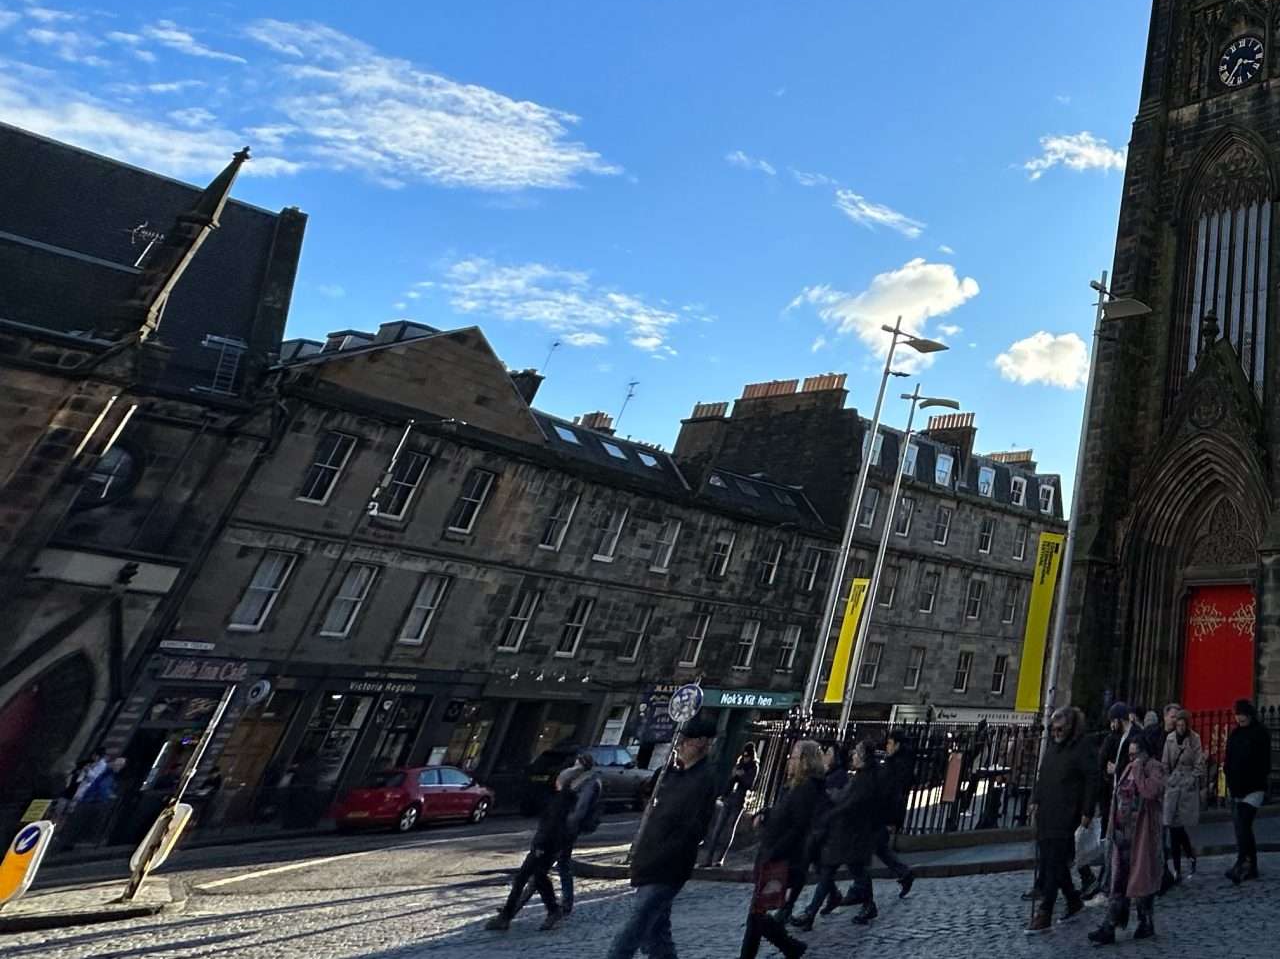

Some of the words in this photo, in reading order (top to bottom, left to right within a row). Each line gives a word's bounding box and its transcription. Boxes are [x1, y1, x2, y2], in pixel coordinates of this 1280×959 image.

[349, 681, 383, 692] Victoria
[384, 682, 417, 694] Regalia
[720, 693, 743, 705] Nok's
[743, 694, 773, 706] Kithen
